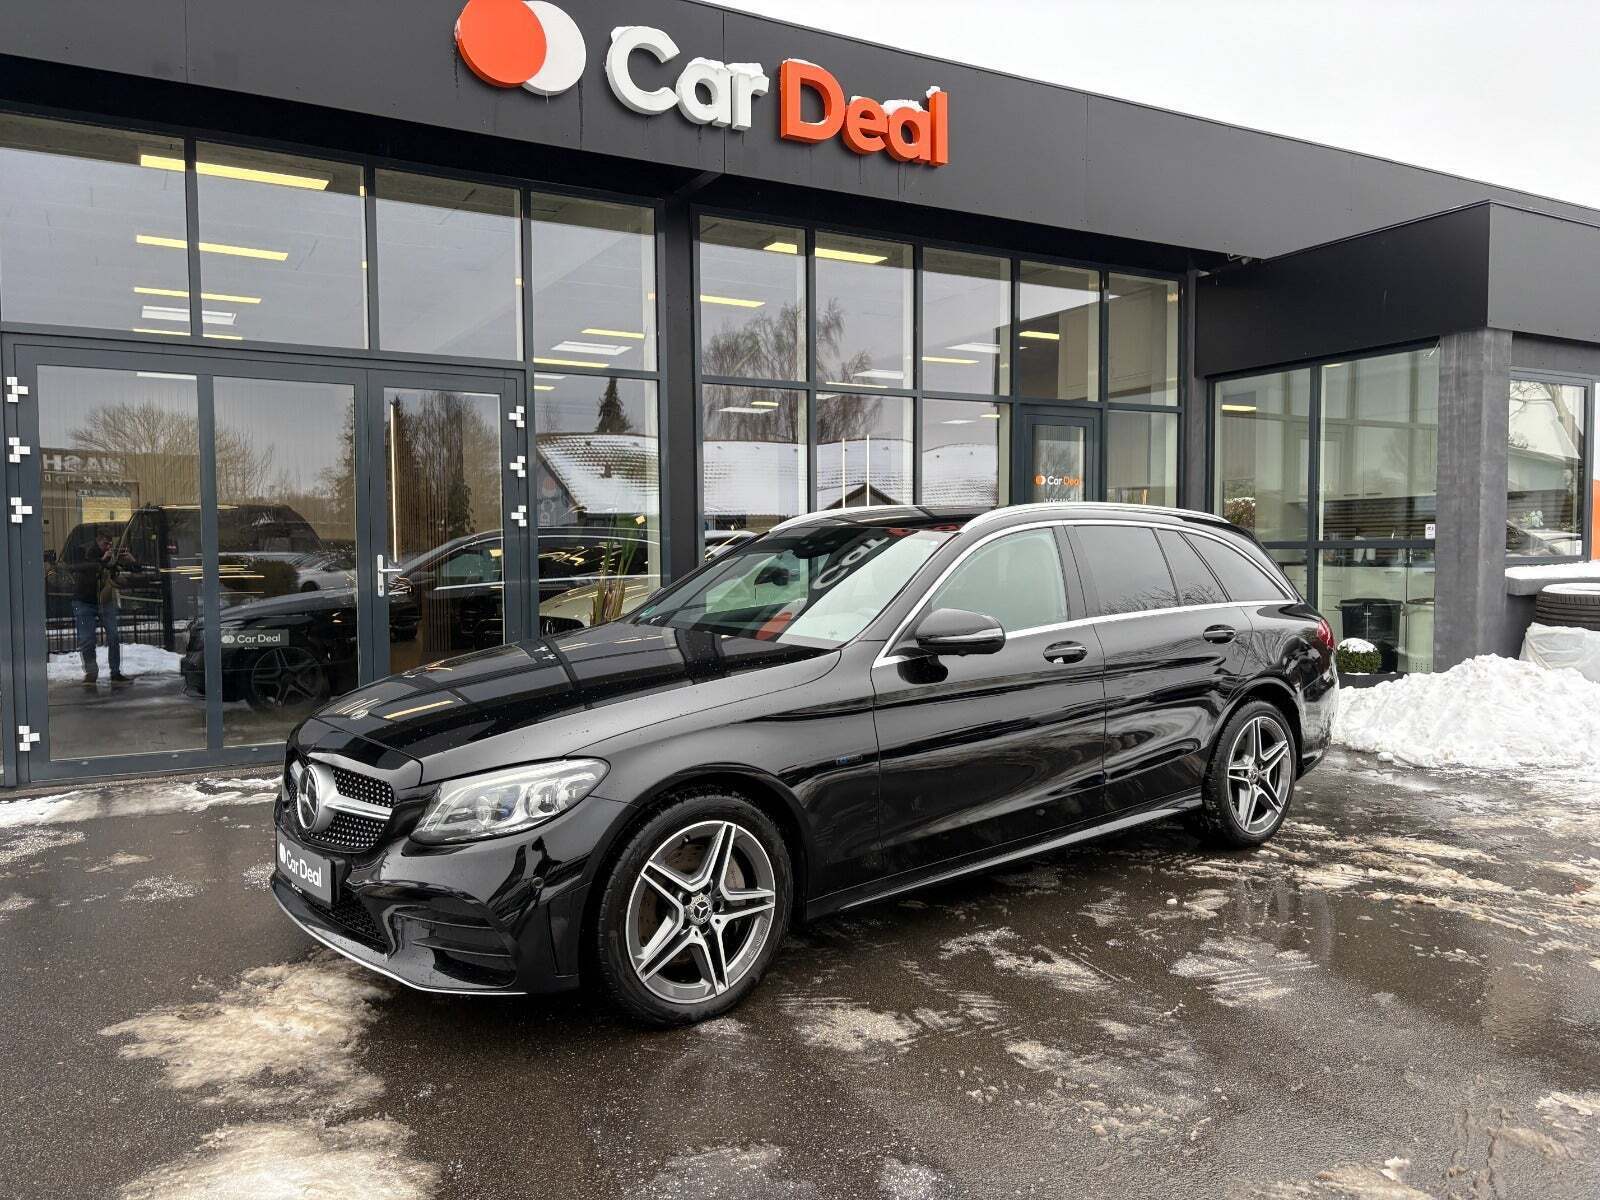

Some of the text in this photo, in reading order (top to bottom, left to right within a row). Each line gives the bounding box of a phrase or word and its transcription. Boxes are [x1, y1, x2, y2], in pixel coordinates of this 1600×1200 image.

[605, 26, 949, 167] Car Deal
[1047, 475, 1062, 486] Car
[237, 633, 281, 644] Car Deal
[286, 849, 299, 875] Car
[299, 858, 322, 888] Deal
